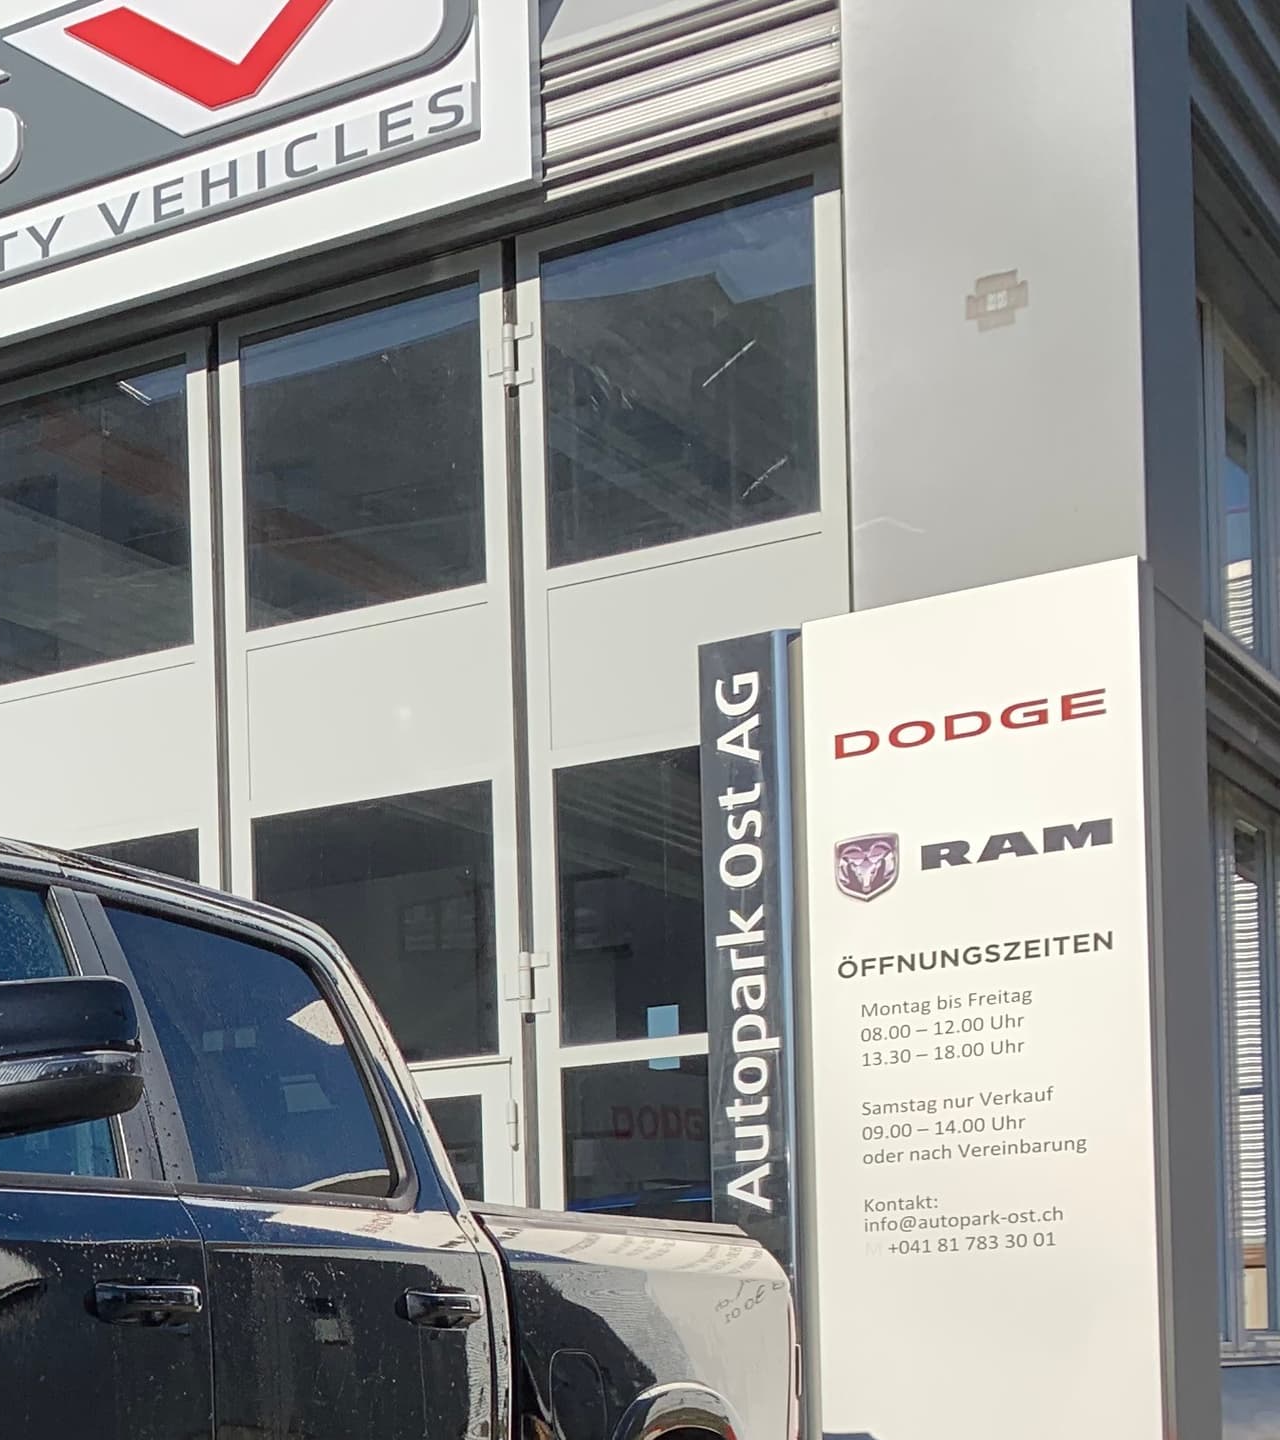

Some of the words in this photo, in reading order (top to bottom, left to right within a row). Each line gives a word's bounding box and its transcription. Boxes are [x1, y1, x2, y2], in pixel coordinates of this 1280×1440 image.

[96, 83, 465, 236] VEHICLES
[715, 671, 761, 763] AG
[834, 688, 1107, 760] DODGE
[718, 782, 764, 889] Ost
[920, 818, 1113, 871] RAM
[836, 930, 1115, 980] ÖFFNUNGSZEITEN
[860, 1001, 932, 1018] Montag
[936, 994, 963, 1011] bis
[967, 989, 1034, 1008] Freitag
[860, 1024, 912, 1043] 08.00
[933, 1017, 985, 1036] 12.00
[990, 1013, 1026, 1031] Uhr
[715, 903, 782, 1213] Autopark
[861, 1048, 912, 1068] 13.30
[933, 1042, 985, 1062] 18.00
[990, 1038, 1026, 1056] Uhr
[861, 1098, 938, 1117] Samstag
[942, 1095, 975, 1111] nur
[979, 1085, 1055, 1107] Verkauf
[611, 1103, 706, 1143] DODG
[861, 1123, 913, 1142] 09.00
[934, 1117, 986, 1136] 14.00
[991, 1114, 1026, 1132] Uhr
[862, 1148, 904, 1166] oder
[909, 1144, 952, 1162] nach
[956, 1138, 1088, 1160] Vereinbarung
[863, 1194, 939, 1214] Kontakt:
[863, 1205, 1065, 1234] info@autopark-ost.ch
[887, 1238, 932, 1255] +041
[936, 1237, 960, 1253] 81
[966, 1235, 1000, 1251] 783
[1004, 1233, 1028, 1249] 30
[1033, 1231, 1057, 1247] 01
